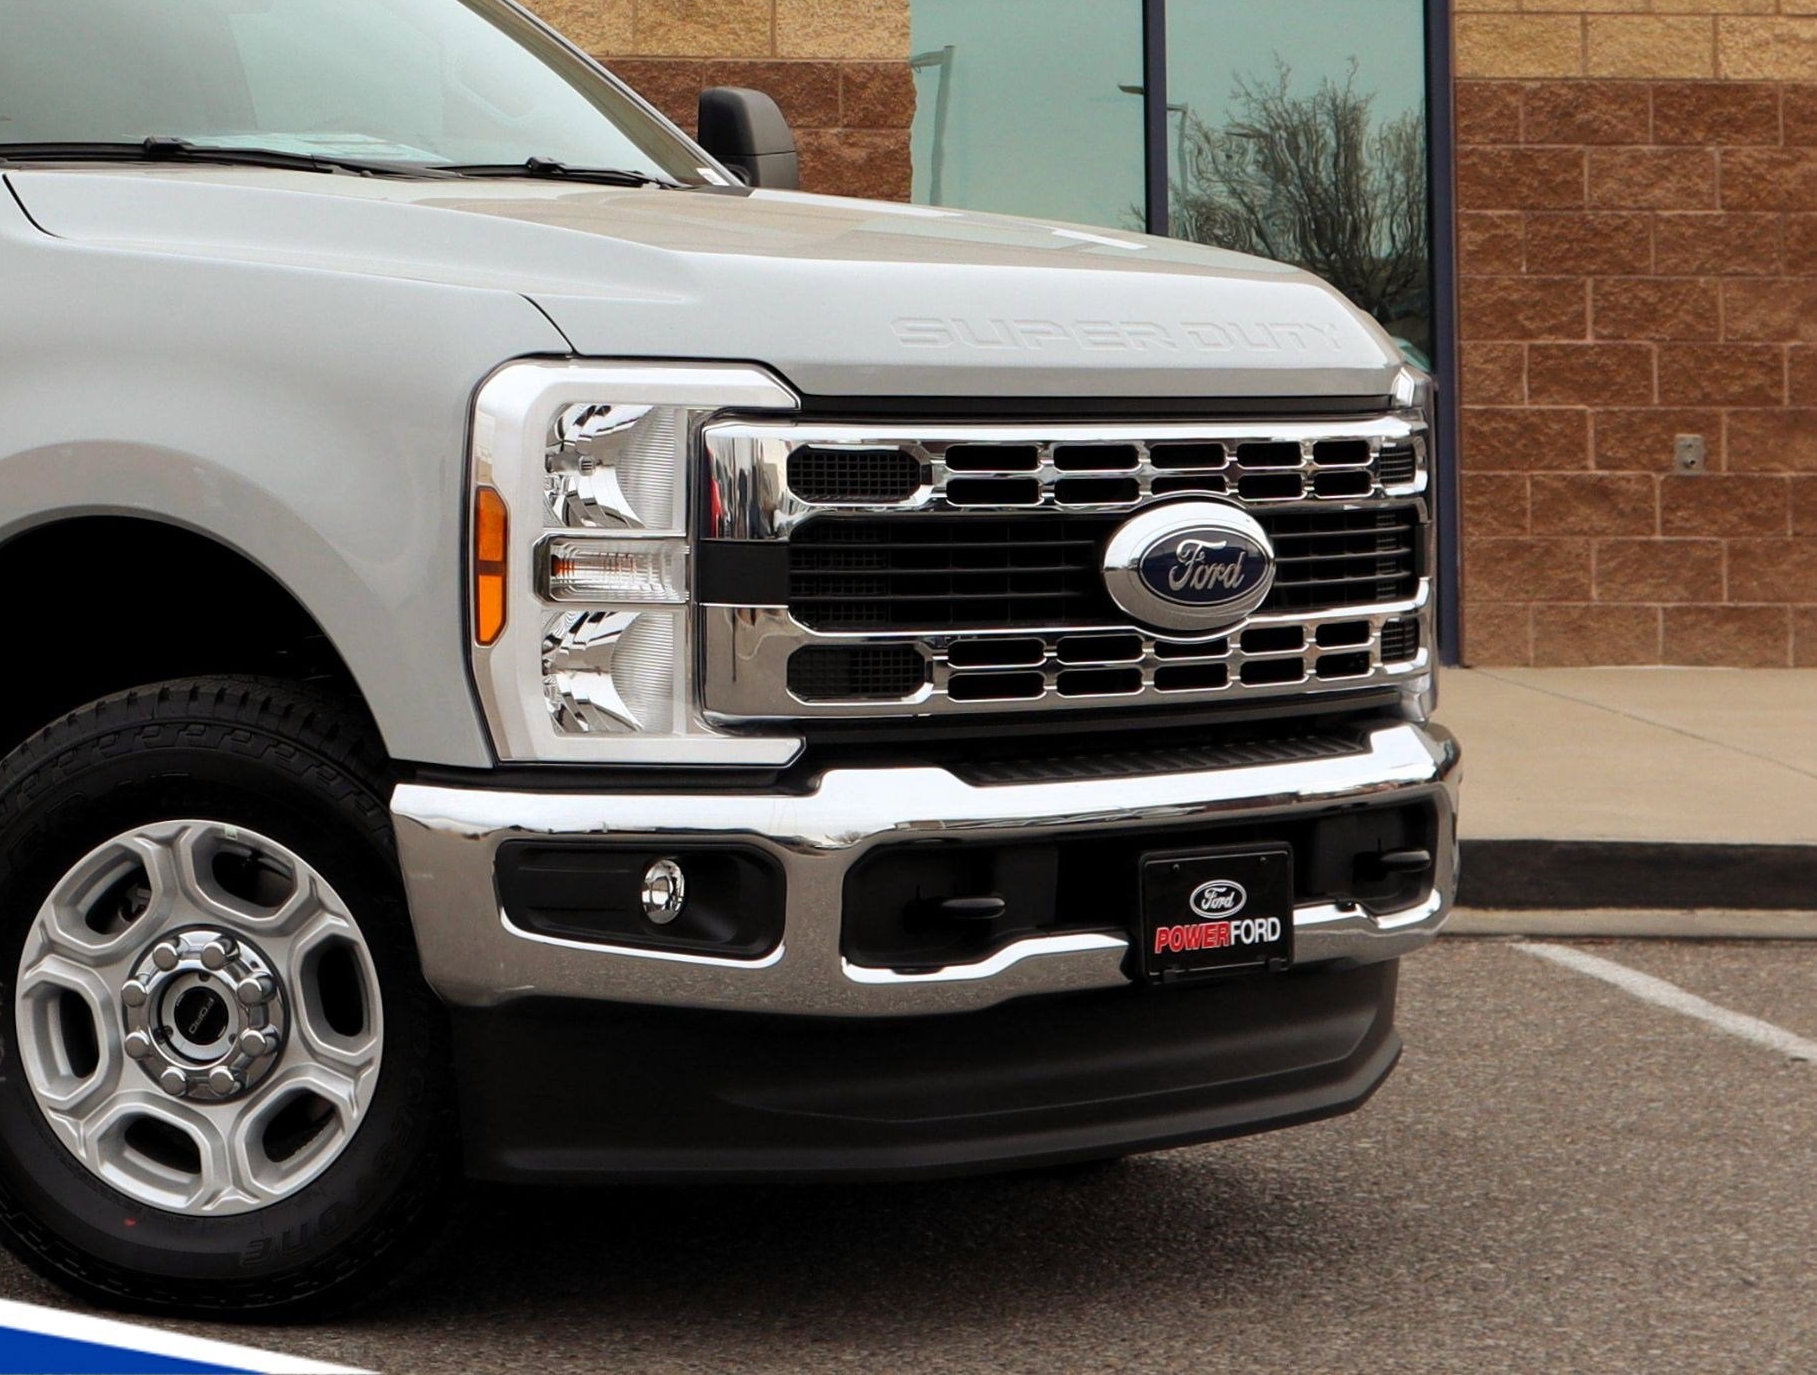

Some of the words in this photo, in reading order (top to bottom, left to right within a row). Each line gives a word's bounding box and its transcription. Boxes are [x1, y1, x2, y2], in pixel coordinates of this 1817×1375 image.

[890, 316, 1179, 352] SUPER
[1180, 321, 1344, 353] DUTY
[1168, 538, 1246, 591] Ford
[1201, 887, 1236, 911] Ford
[1154, 916, 1282, 954] POWERFORD
[187, 997, 215, 1035] FORD
